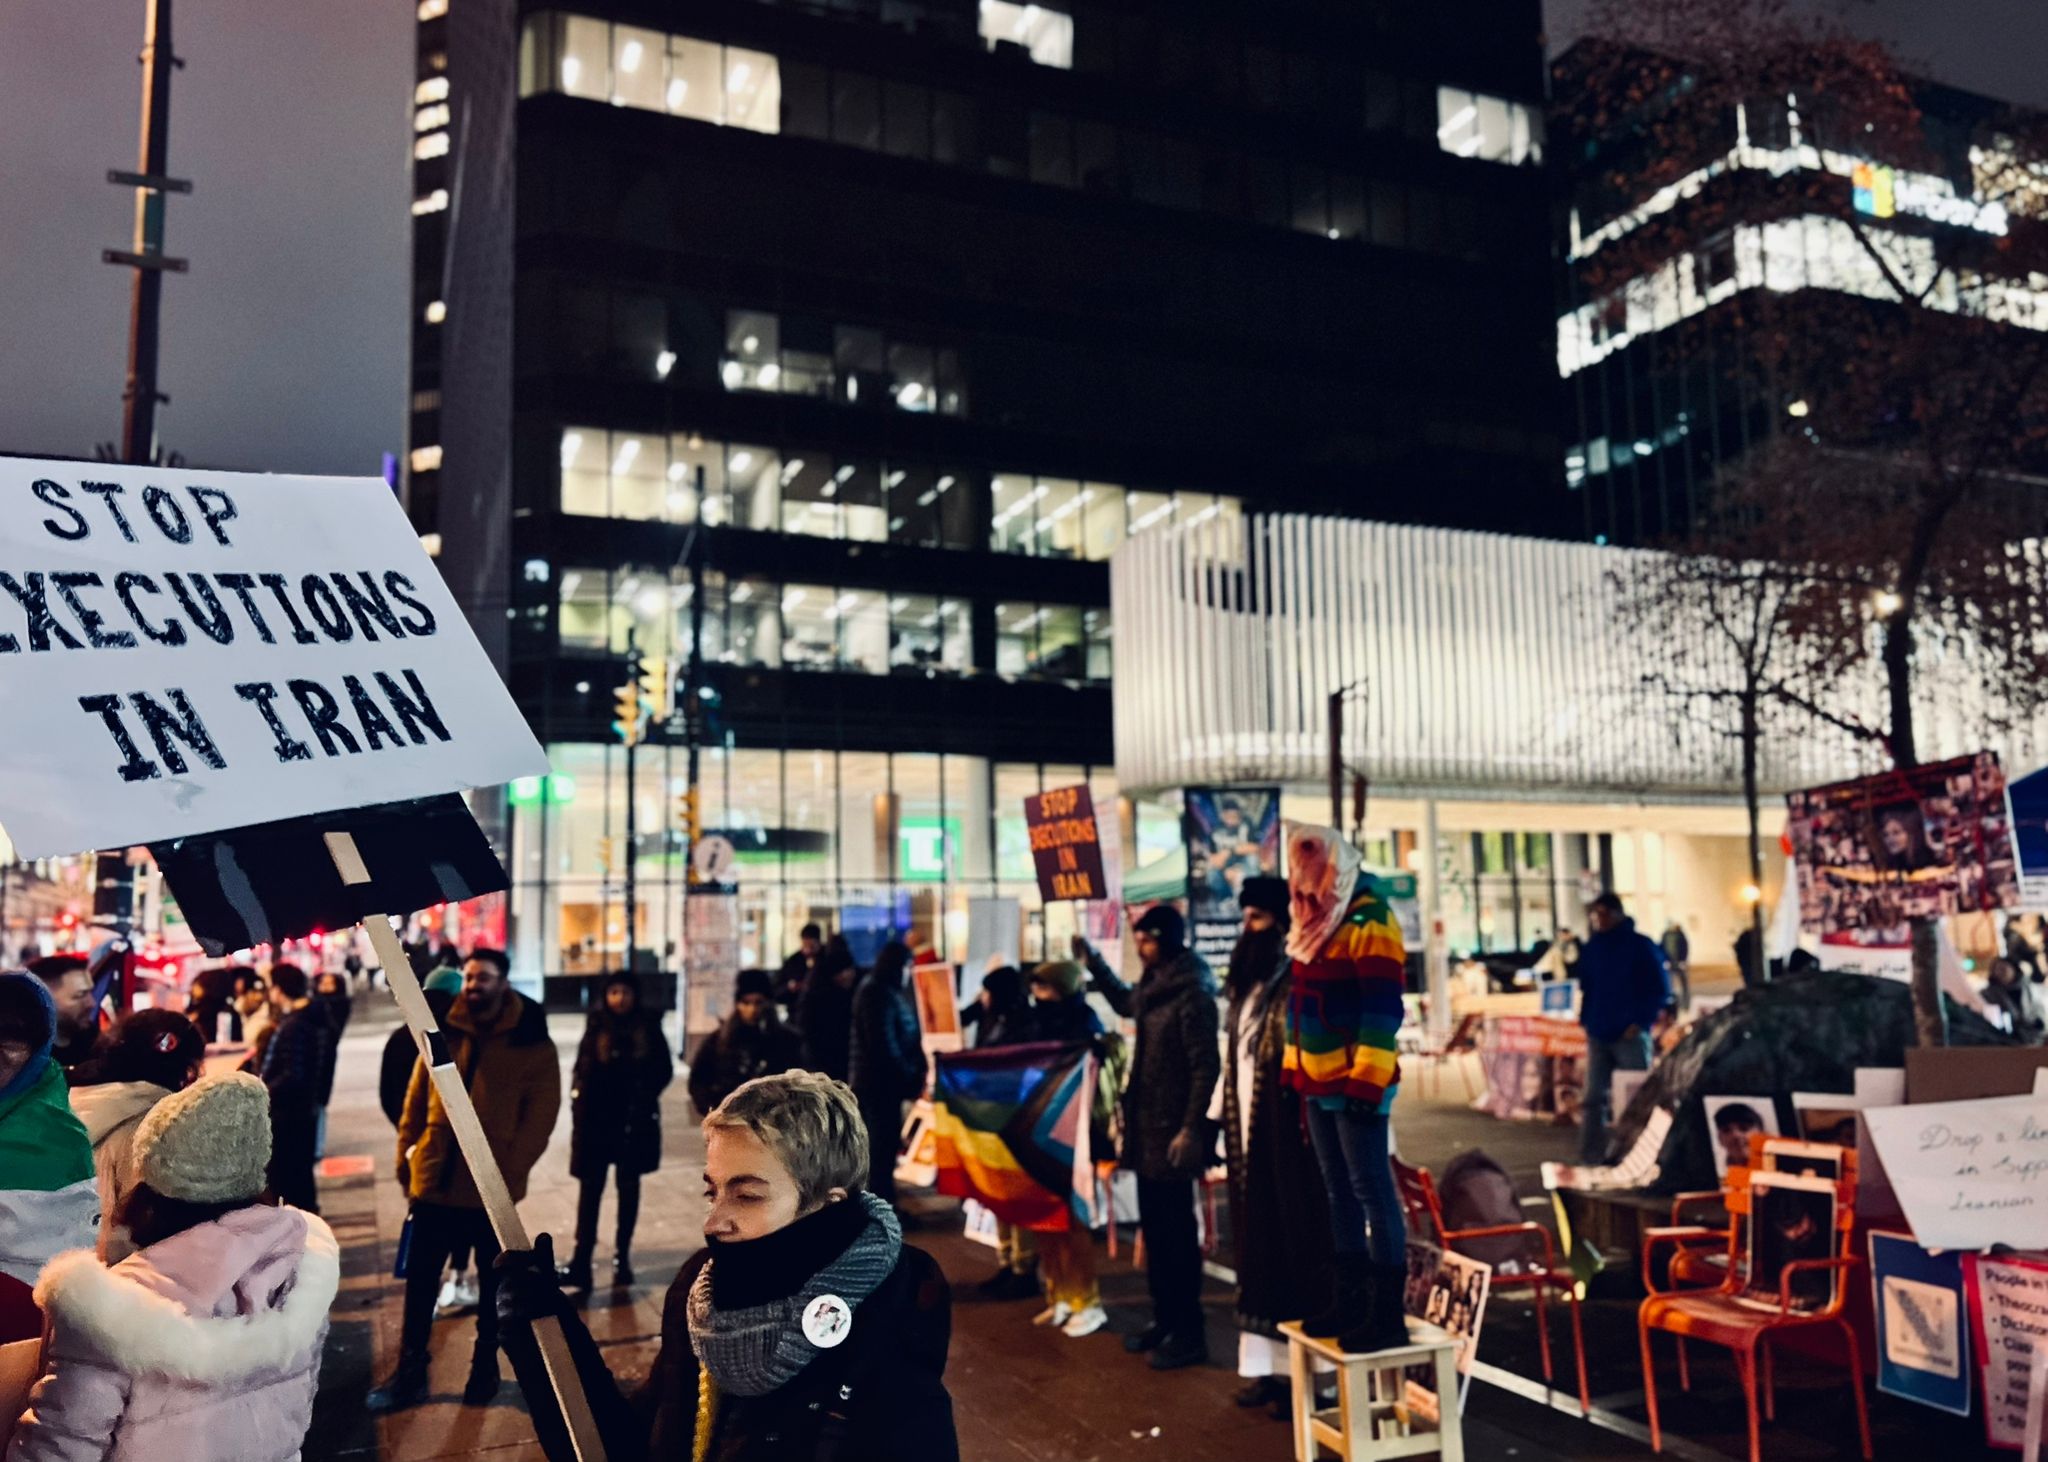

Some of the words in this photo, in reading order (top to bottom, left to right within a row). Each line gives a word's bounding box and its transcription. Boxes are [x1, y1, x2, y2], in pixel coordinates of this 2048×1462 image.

[32, 478, 239, 547] STOP
[0, 570, 437, 653] XECUTIONS
[78, 687, 228, 782] IN
[234, 668, 452, 763] IRAN
[1040, 787, 1077, 818] STOP
[1057, 847, 1077, 871] IN
[1051, 872, 1093, 899] IRAN
[1919, 1123, 1982, 1155] Drop
[1955, 1163, 1980, 1175] in
[1949, 1192, 2034, 1211] Iranian
[1985, 1268, 2028, 1288] People
